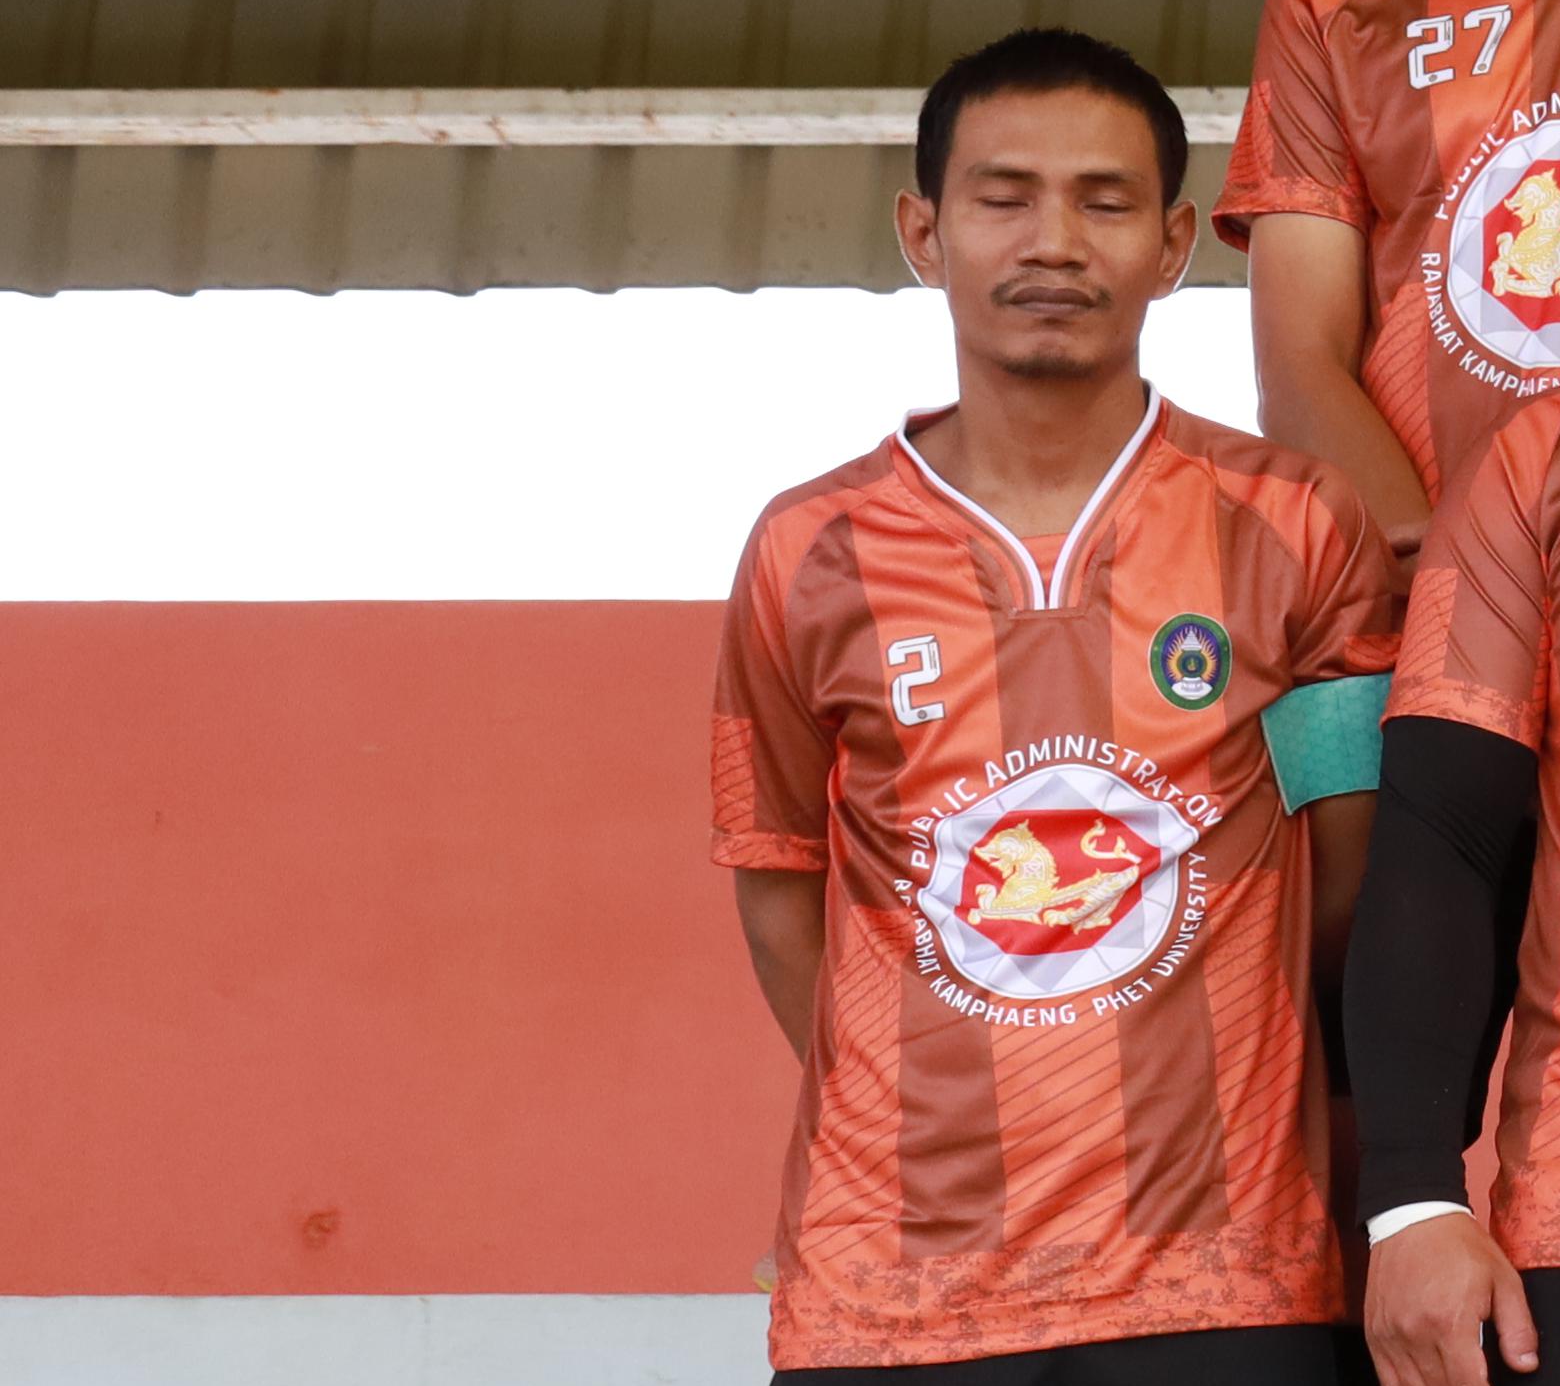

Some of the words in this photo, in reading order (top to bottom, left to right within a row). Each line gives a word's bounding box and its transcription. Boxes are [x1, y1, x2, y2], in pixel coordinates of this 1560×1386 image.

[1407, 4, 1512, 90] 27
[887, 633, 946, 727] 2
[930, 974, 1078, 1027] KAMPHAENG
[1092, 977, 1154, 1017] PHET
[1152, 851, 1207, 977] UNIVERSITY
